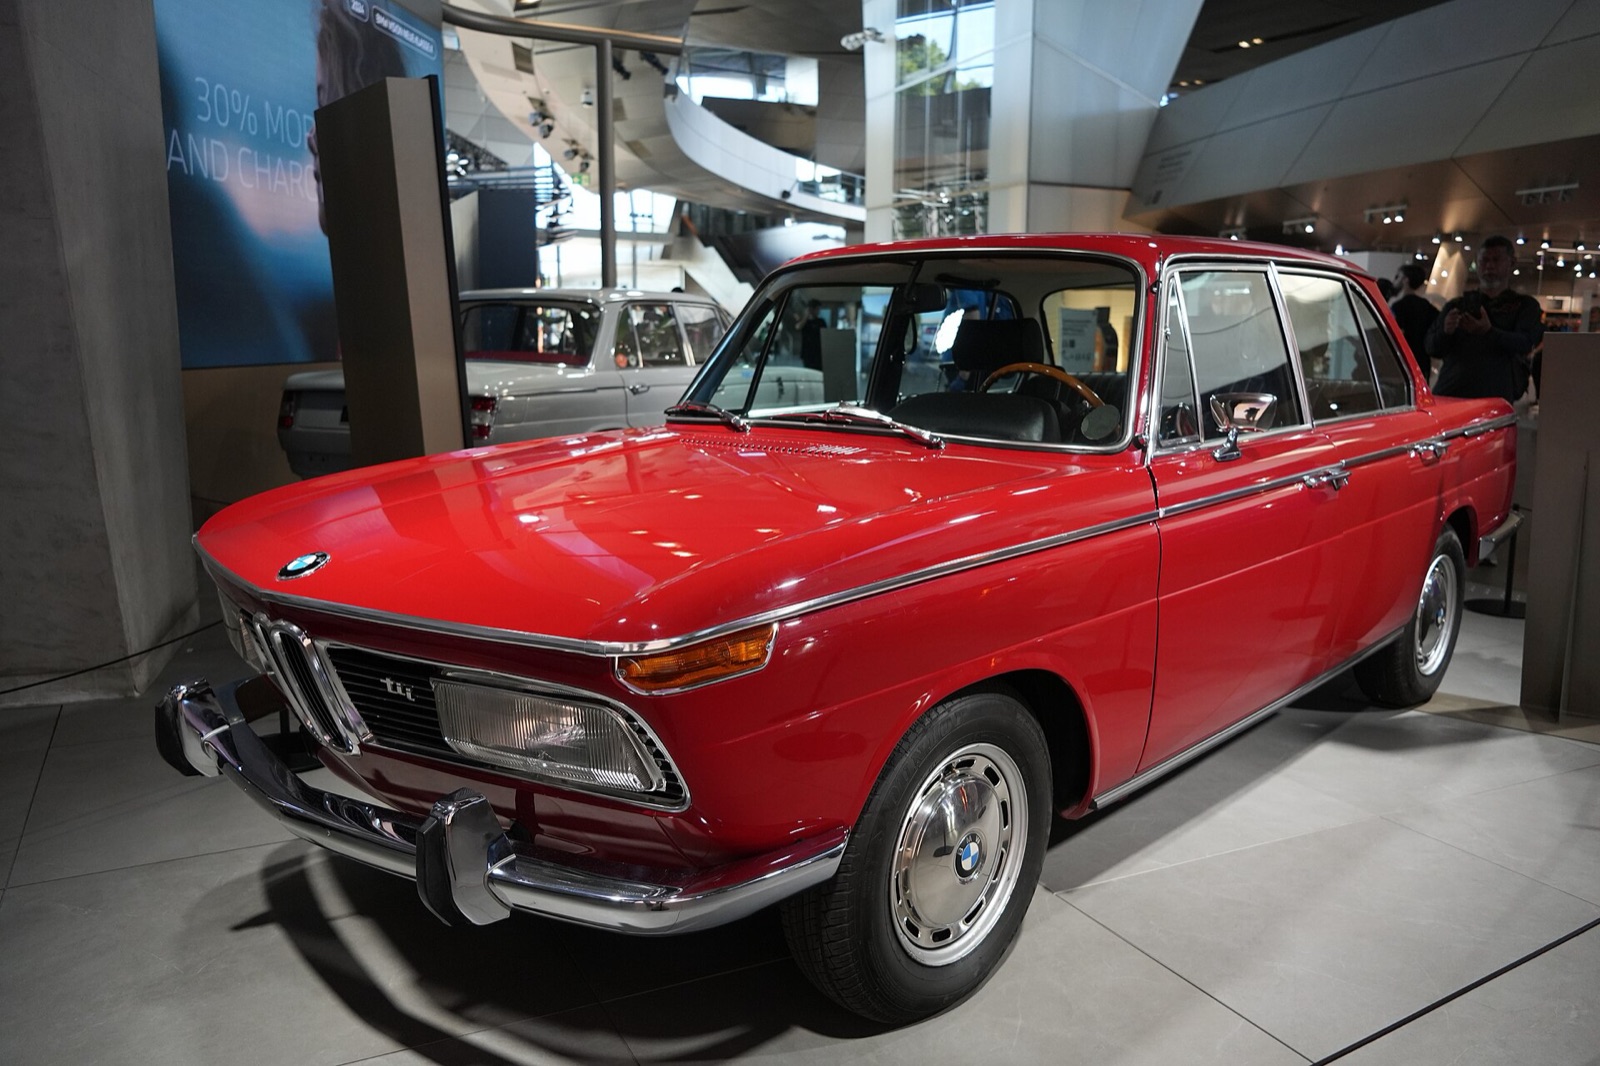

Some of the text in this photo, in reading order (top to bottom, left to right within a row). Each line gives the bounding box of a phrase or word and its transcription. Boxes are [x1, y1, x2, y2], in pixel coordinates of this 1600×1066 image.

[196, 77, 258, 136] 30%
[167, 129, 230, 183] AND
[958, 834, 981, 856] BMW
